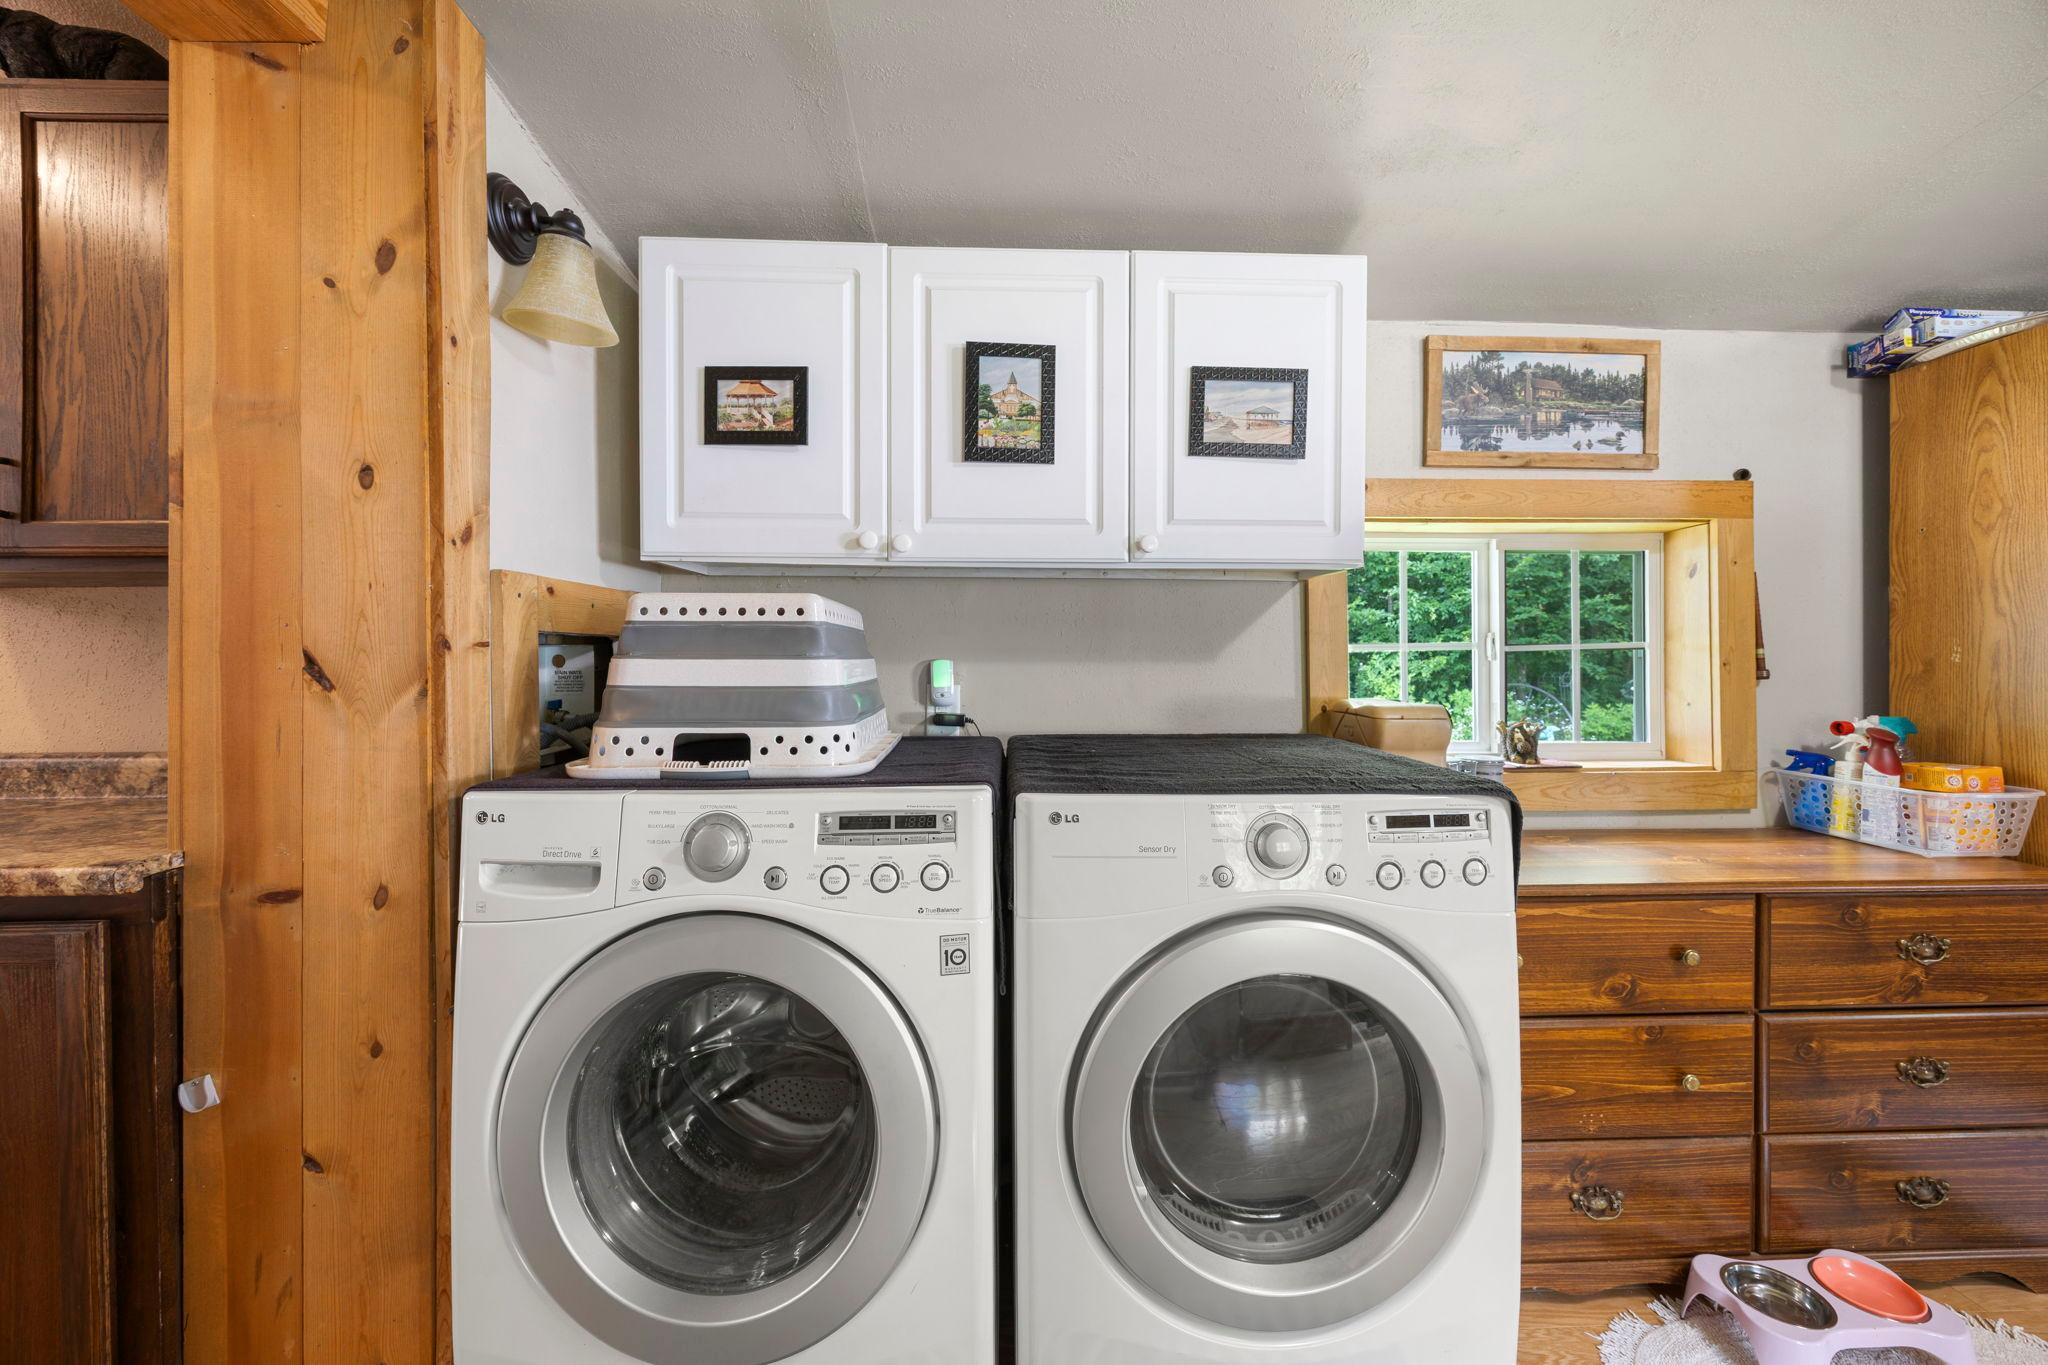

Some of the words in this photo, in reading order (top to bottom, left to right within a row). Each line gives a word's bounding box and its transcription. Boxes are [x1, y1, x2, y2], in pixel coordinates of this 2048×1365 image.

[491, 813, 506, 823] LG
[1064, 814, 1080, 823] LG
[542, 850, 563, 858] Direct
[564, 850, 583, 858] Drive
[1138, 845, 1162, 853] Sensor
[1163, 845, 1176, 854] Dry
[944, 948, 967, 966] 10
